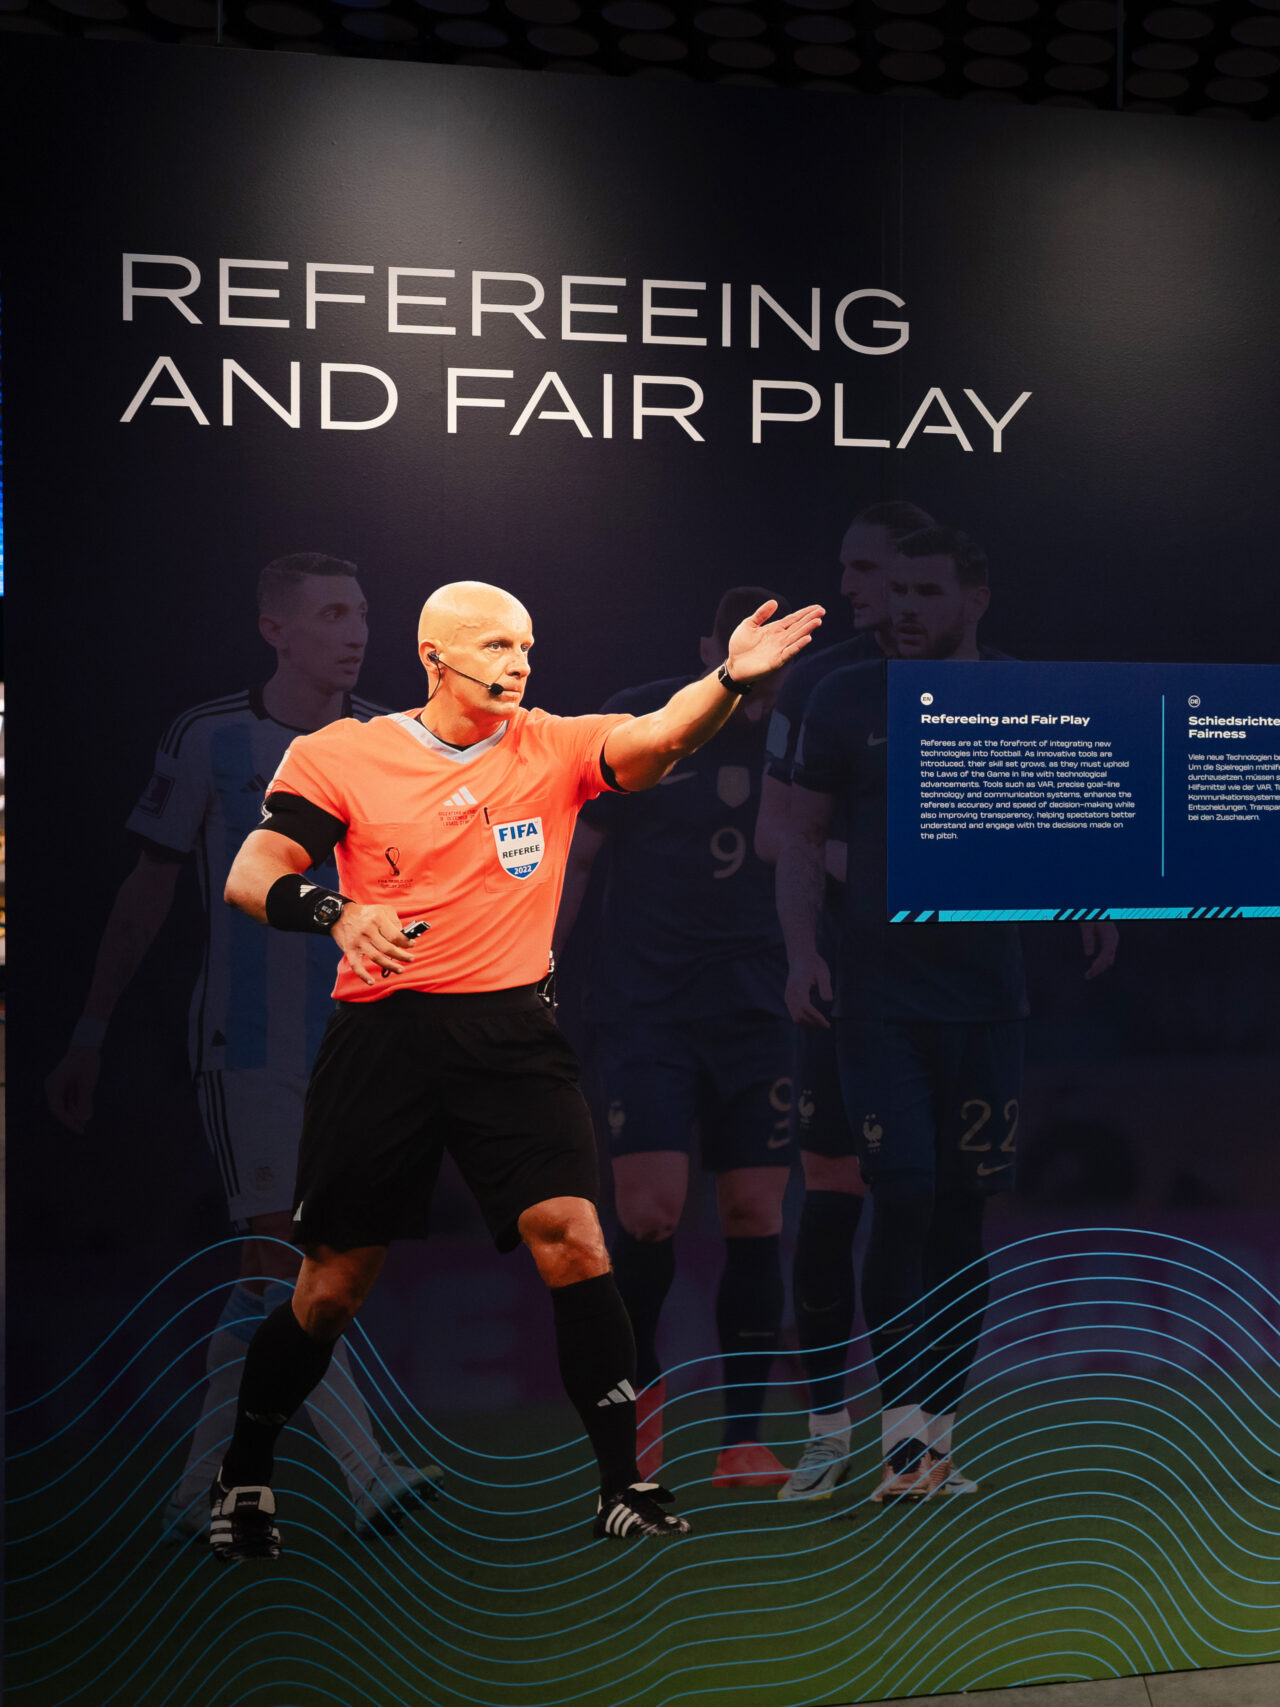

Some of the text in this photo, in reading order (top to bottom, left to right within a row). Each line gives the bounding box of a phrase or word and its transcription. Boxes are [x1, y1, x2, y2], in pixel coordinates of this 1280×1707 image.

[122, 252, 910, 356] REFEREEING
[119, 356, 1033, 453] AND FAIR PLAY
[921, 714, 1090, 726] Refereeing and Fair Play
[1189, 729, 1246, 738] Fairness
[1050, 740, 1093, 748] integrating
[920, 750, 971, 758] technologies
[1226, 754, 1272, 762] Technologien
[1060, 760, 1078, 768] they
[1103, 760, 1129, 769] uphold
[1056, 770, 1107, 779] technological
[1057, 781, 1085, 789] precise
[1087, 781, 1120, 789] goal-line
[920, 791, 965, 799] technology
[1047, 791, 1081, 799] systems,
[1013, 801, 1037, 809] speed
[1049, 801, 1113, 809] decision-making
[939, 811, 978, 820] improving
[980, 811, 1034, 819] transparency,
[1037, 811, 1065, 819] helping
[1066, 811, 1109, 819] spectators
[498, 822, 538, 842] FIFA
[936, 832, 958, 840] pitch.
[502, 845, 540, 859] REFEREE
[710, 826, 746, 879] 9
[514, 865, 532, 875] 2022
